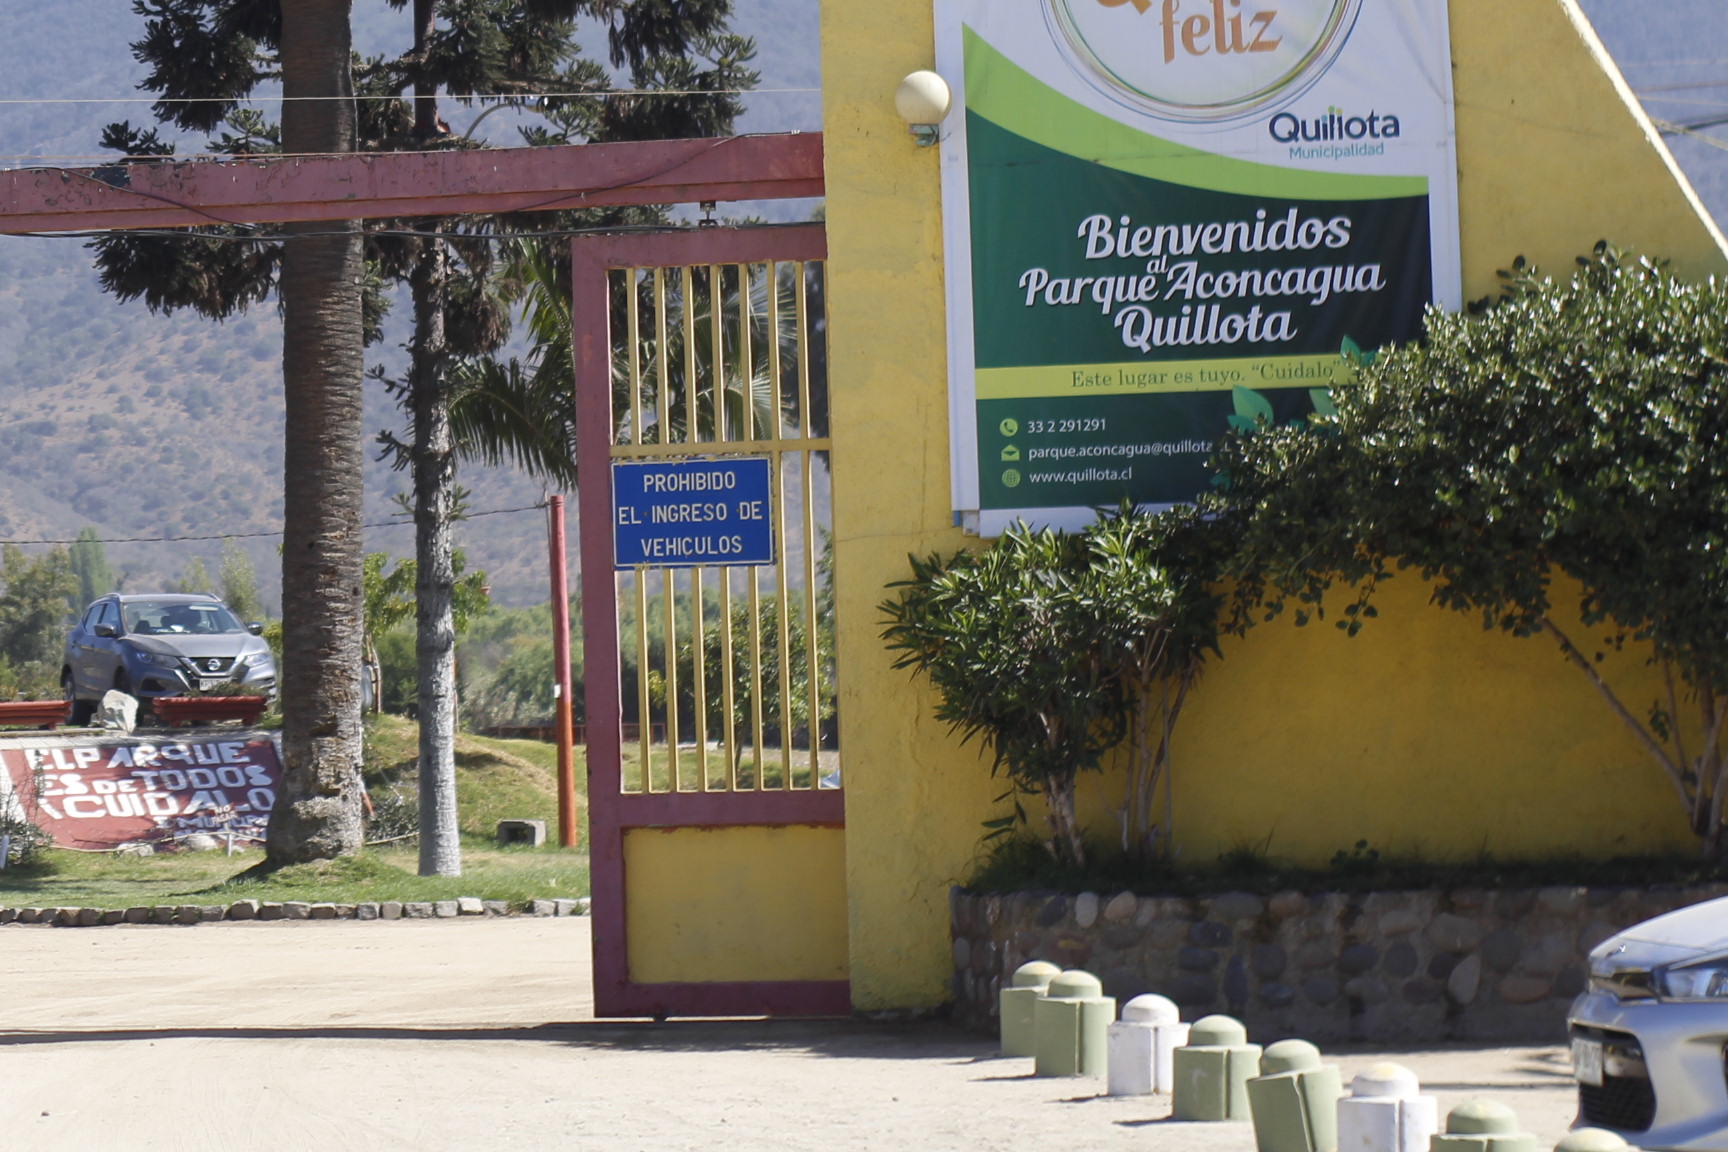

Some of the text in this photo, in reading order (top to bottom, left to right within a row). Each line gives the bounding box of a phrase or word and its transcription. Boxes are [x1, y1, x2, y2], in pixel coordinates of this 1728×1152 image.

[1269, 106, 1400, 143] Quillota
[1289, 142, 1384, 160] Municipalidad
[1077, 208, 1352, 259] Bienvenidos
[1147, 255, 1169, 274] al
[1018, 261, 1386, 315] Parque Aconcagua
[1114, 303, 1298, 354] Quillota
[1071, 371, 1112, 387] Este
[1118, 370, 1168, 390] lugar
[1174, 372, 1194, 384] es
[1200, 367, 1245, 386] tuyo.
[1028, 419, 1106, 433] 33 2 291291
[643, 471, 736, 493] PROHIBIDO
[1029, 467, 1132, 484] www.quillota.cl
[618, 501, 763, 525] EL INGRESO DE
[641, 535, 743, 557] VEHICULOS
[35, 765, 272, 796] ES DE TODOS
